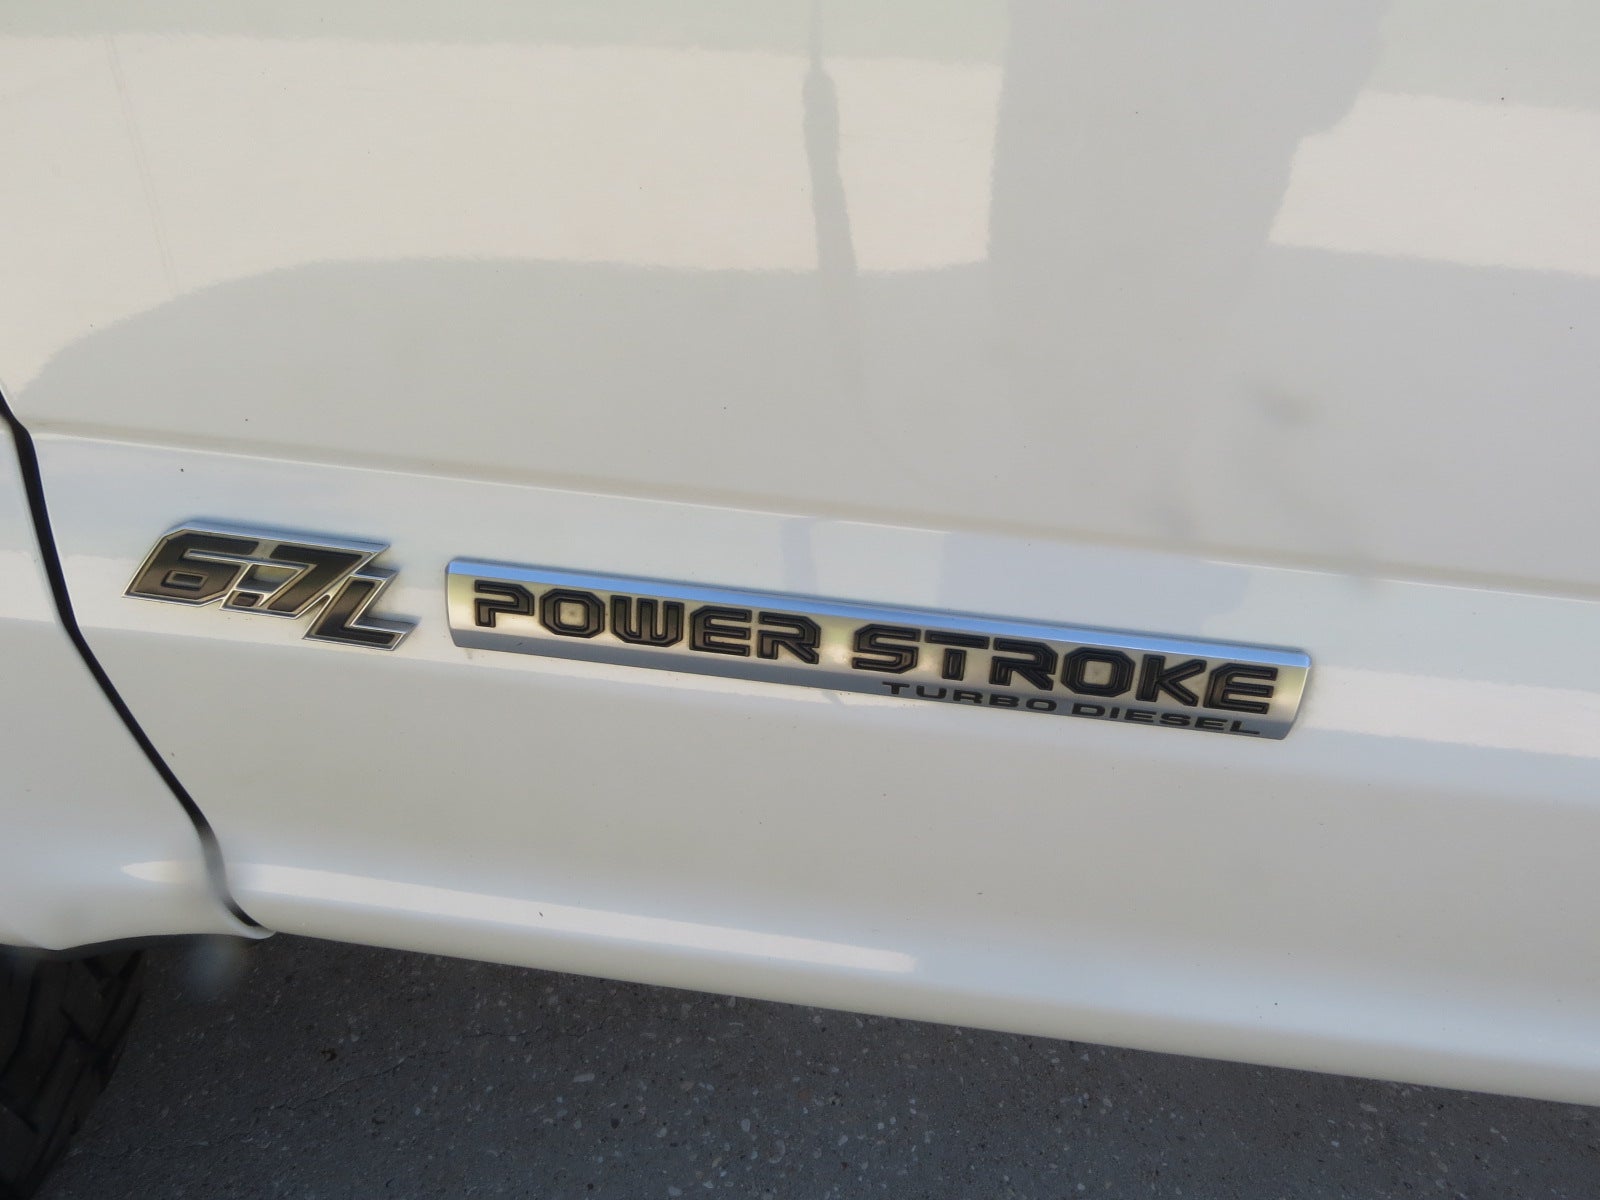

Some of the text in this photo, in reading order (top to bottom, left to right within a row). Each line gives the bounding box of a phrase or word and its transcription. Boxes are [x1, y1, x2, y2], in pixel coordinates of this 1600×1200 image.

[124, 527, 1278, 715] 6.7L POWER STROKE
[882, 681, 1261, 735] TURBO DIESEL
